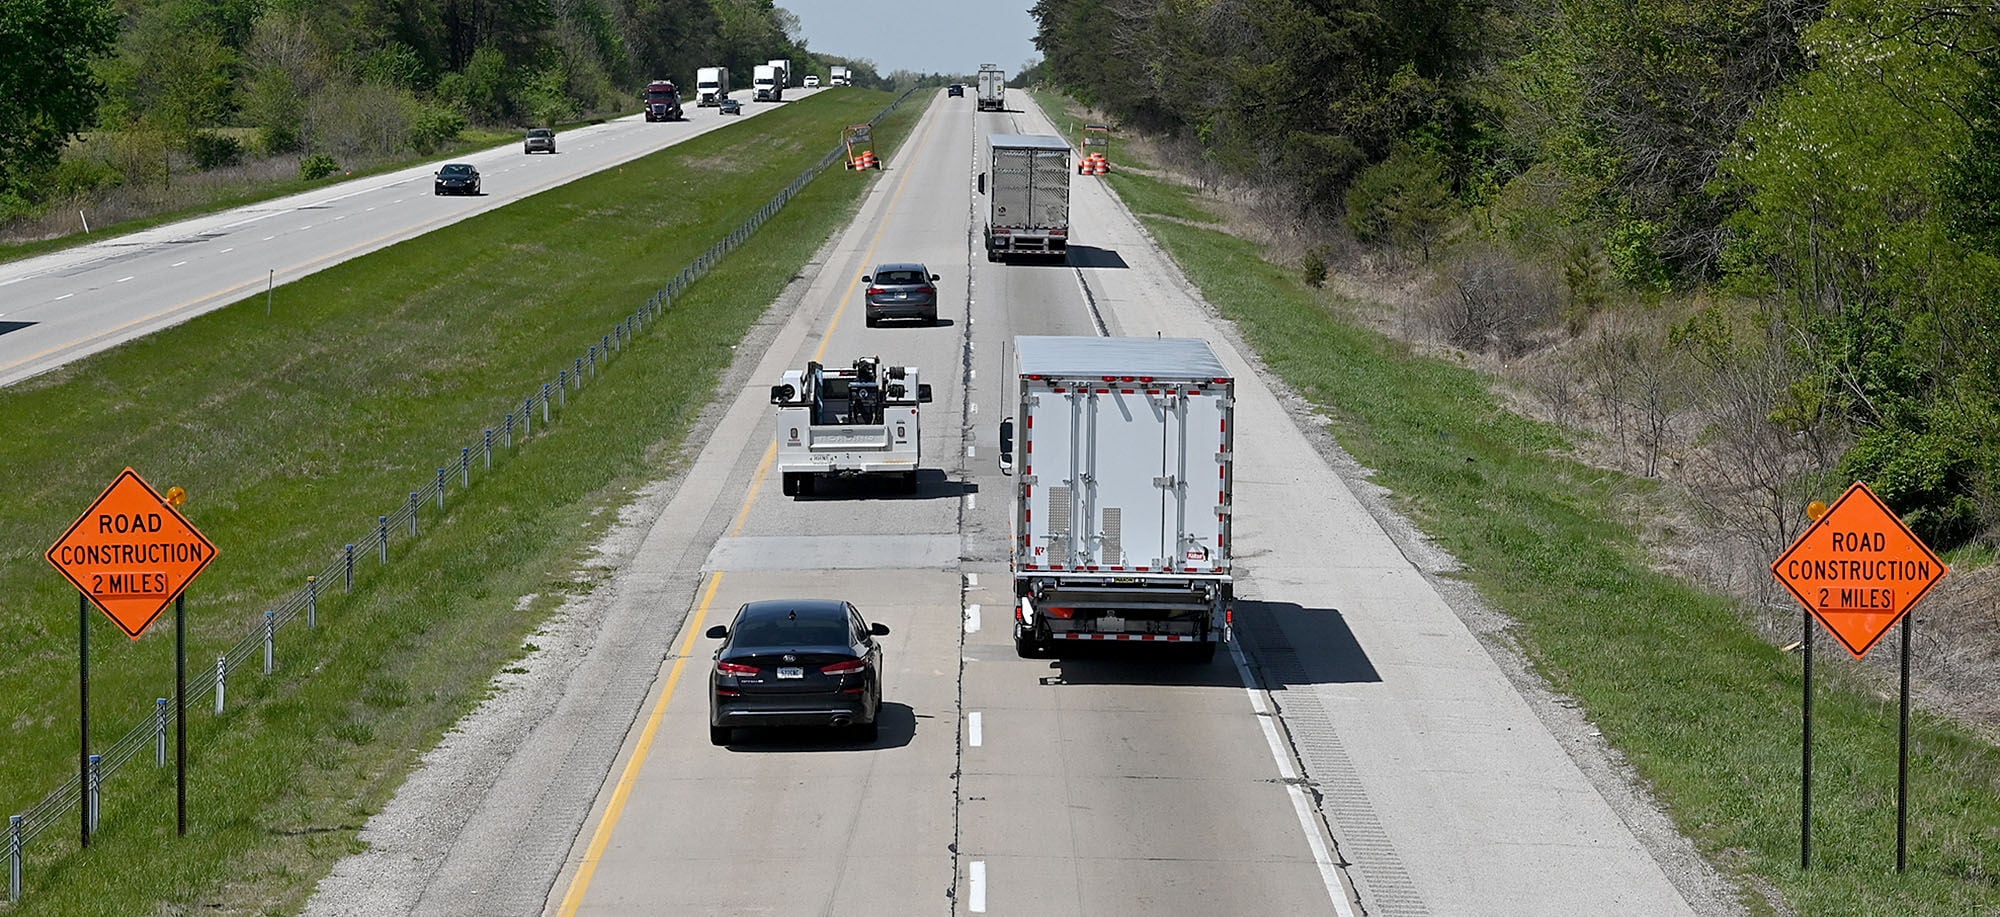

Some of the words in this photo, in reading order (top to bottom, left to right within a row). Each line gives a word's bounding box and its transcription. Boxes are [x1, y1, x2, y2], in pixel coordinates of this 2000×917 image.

[99, 513, 162, 534] ROAD
[1832, 532, 1886, 552] ROAD
[61, 543, 203, 565] CONSTRUCTION
[1788, 560, 1930, 581] CONSTRUCTION
[92, 575, 104, 594] 2
[109, 573, 165, 594] MILES
[1819, 588, 1829, 608] 2
[1840, 588, 1891, 608] MILES
